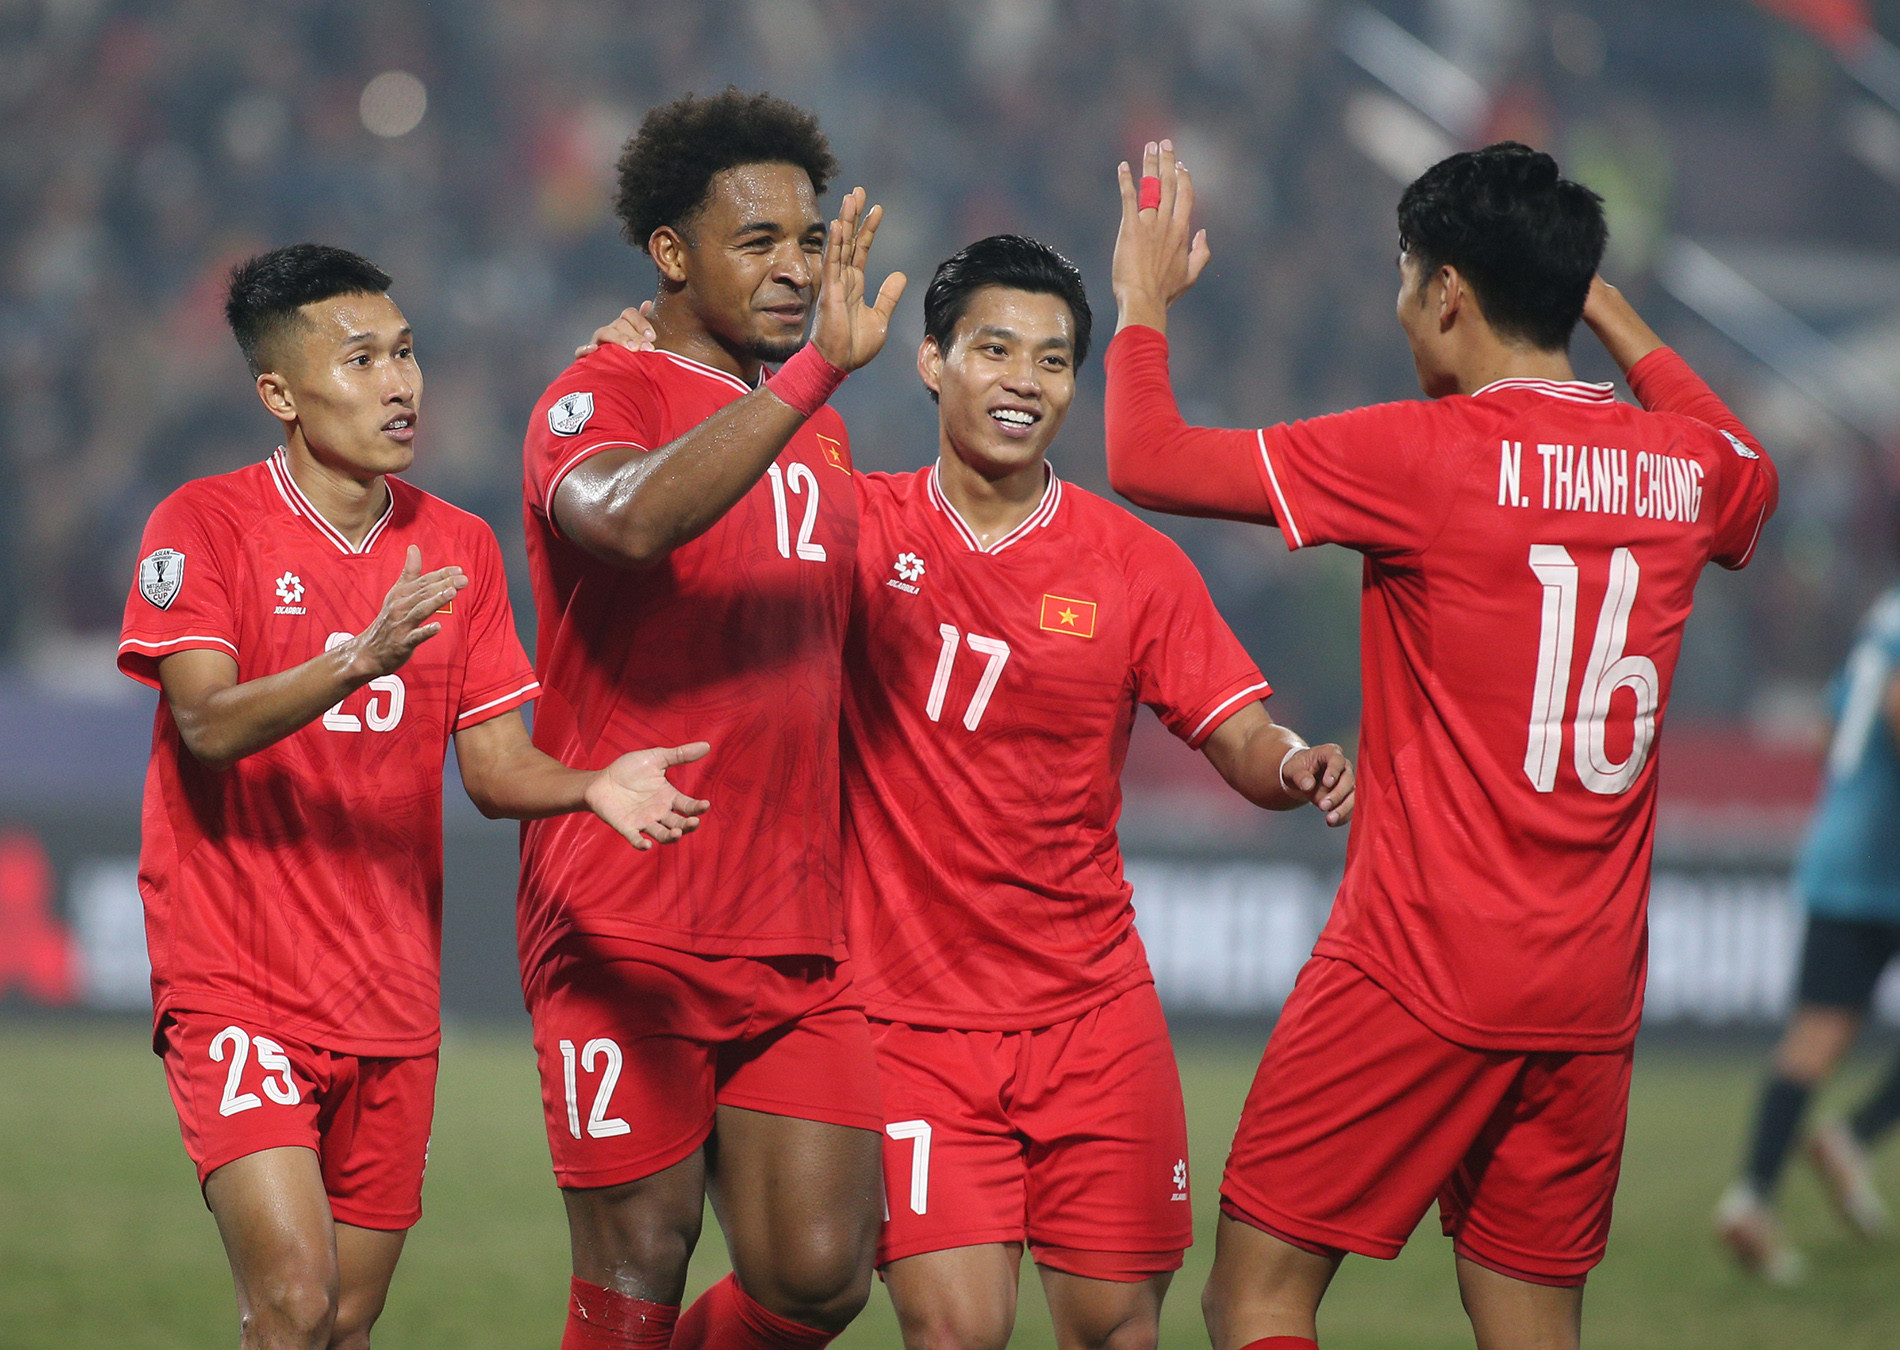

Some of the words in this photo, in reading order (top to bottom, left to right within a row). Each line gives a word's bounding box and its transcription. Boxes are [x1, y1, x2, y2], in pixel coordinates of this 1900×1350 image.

[767, 461, 827, 562] 12
[1498, 440, 1529, 508] N.
[1537, 444, 1628, 515] THANH
[1635, 451, 1704, 524] CHUNG
[153, 592, 168, 601] CUP
[925, 623, 1011, 732] 17
[1523, 544, 1659, 795] 16
[209, 1025, 301, 1117] 25
[559, 1038, 632, 1139] 12
